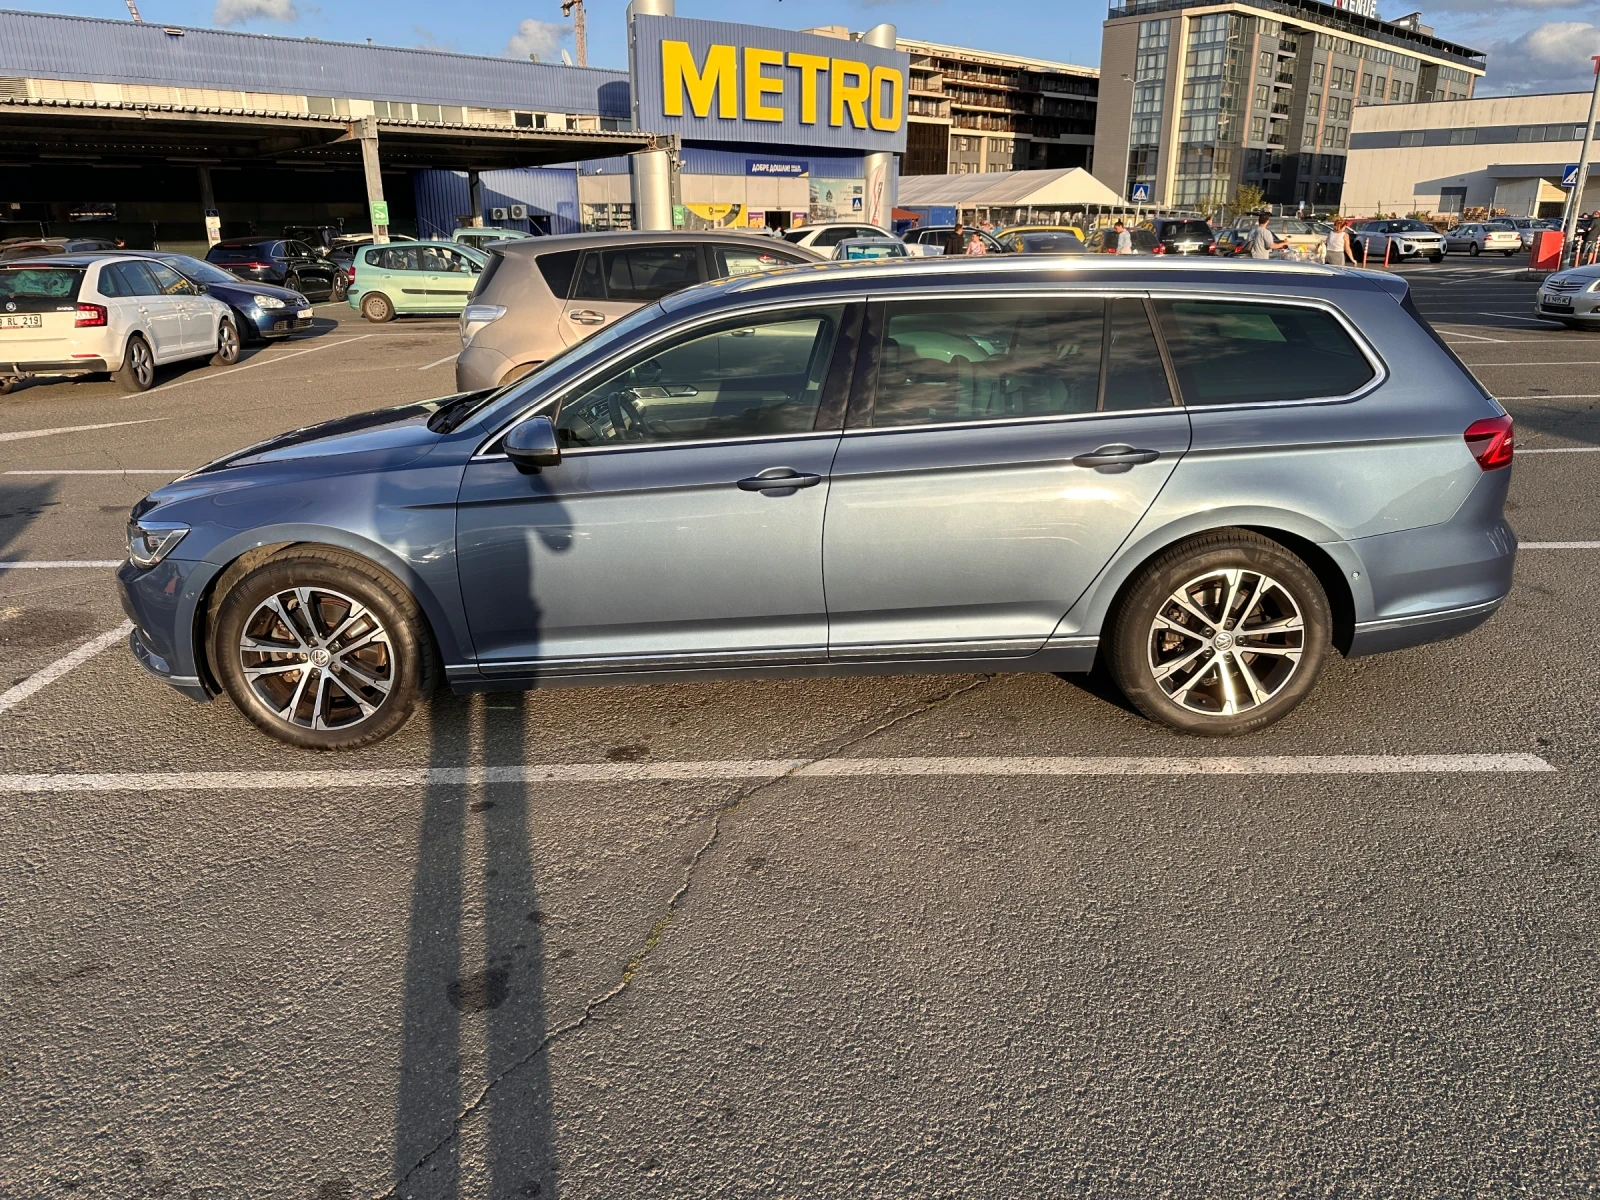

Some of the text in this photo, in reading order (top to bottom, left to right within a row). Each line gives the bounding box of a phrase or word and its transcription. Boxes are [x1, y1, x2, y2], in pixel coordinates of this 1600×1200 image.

[661, 39, 903, 132] METRO
[752, 164, 770, 172] ДОБРЕ
[7, 317, 18, 326] RL
[22, 316, 39, 325] 219
